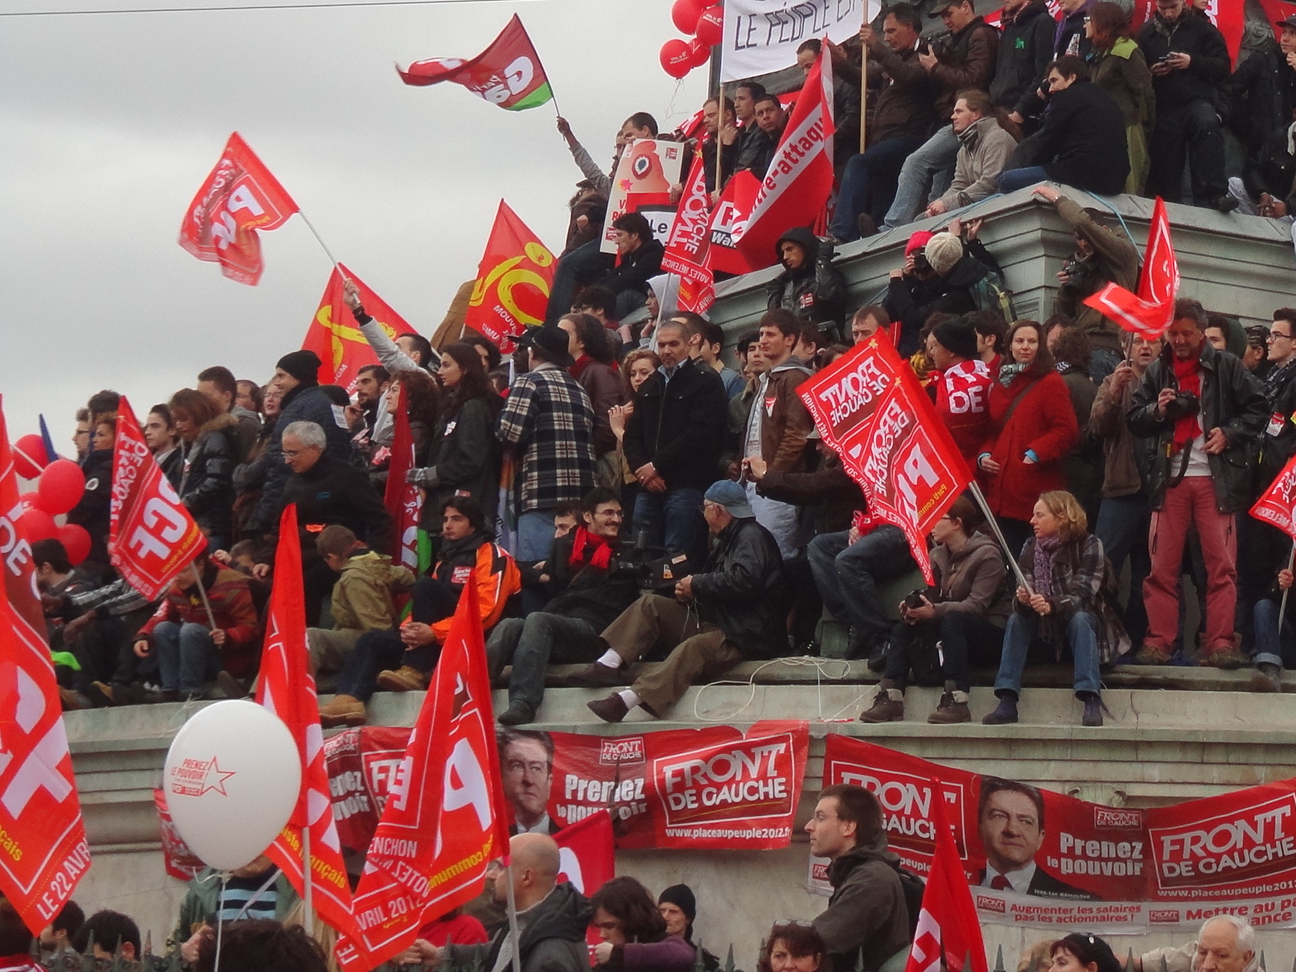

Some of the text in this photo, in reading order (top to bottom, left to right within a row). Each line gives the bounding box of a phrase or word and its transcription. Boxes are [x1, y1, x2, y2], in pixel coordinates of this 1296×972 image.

[735, 15, 757, 51] LE
[949, 385, 985, 414] DE
[602, 739, 641, 755] FRONT
[663, 743, 786, 794] FRONT
[668, 778, 788, 811] DE GAUCHE
[1097, 810, 1139, 822] FRONT
[665, 827, 792, 840] www.placeaupeuple2012.fr
[1059, 832, 1143, 860] Prenez
[1160, 804, 1292, 861] FRONT
[1047, 856, 1144, 877] le pouvoir
[1162, 836, 1296, 878] DE GAUCHE
[36, 837, 91, 921] LE 22 AVR
[1010, 903, 1142, 917] Augmenter les salaires
[1014, 913, 1035, 923] pas
[1037, 912, 1053, 923] les
[1056, 913, 1128, 924] actionnaires
[1253, 901, 1277, 914] au
